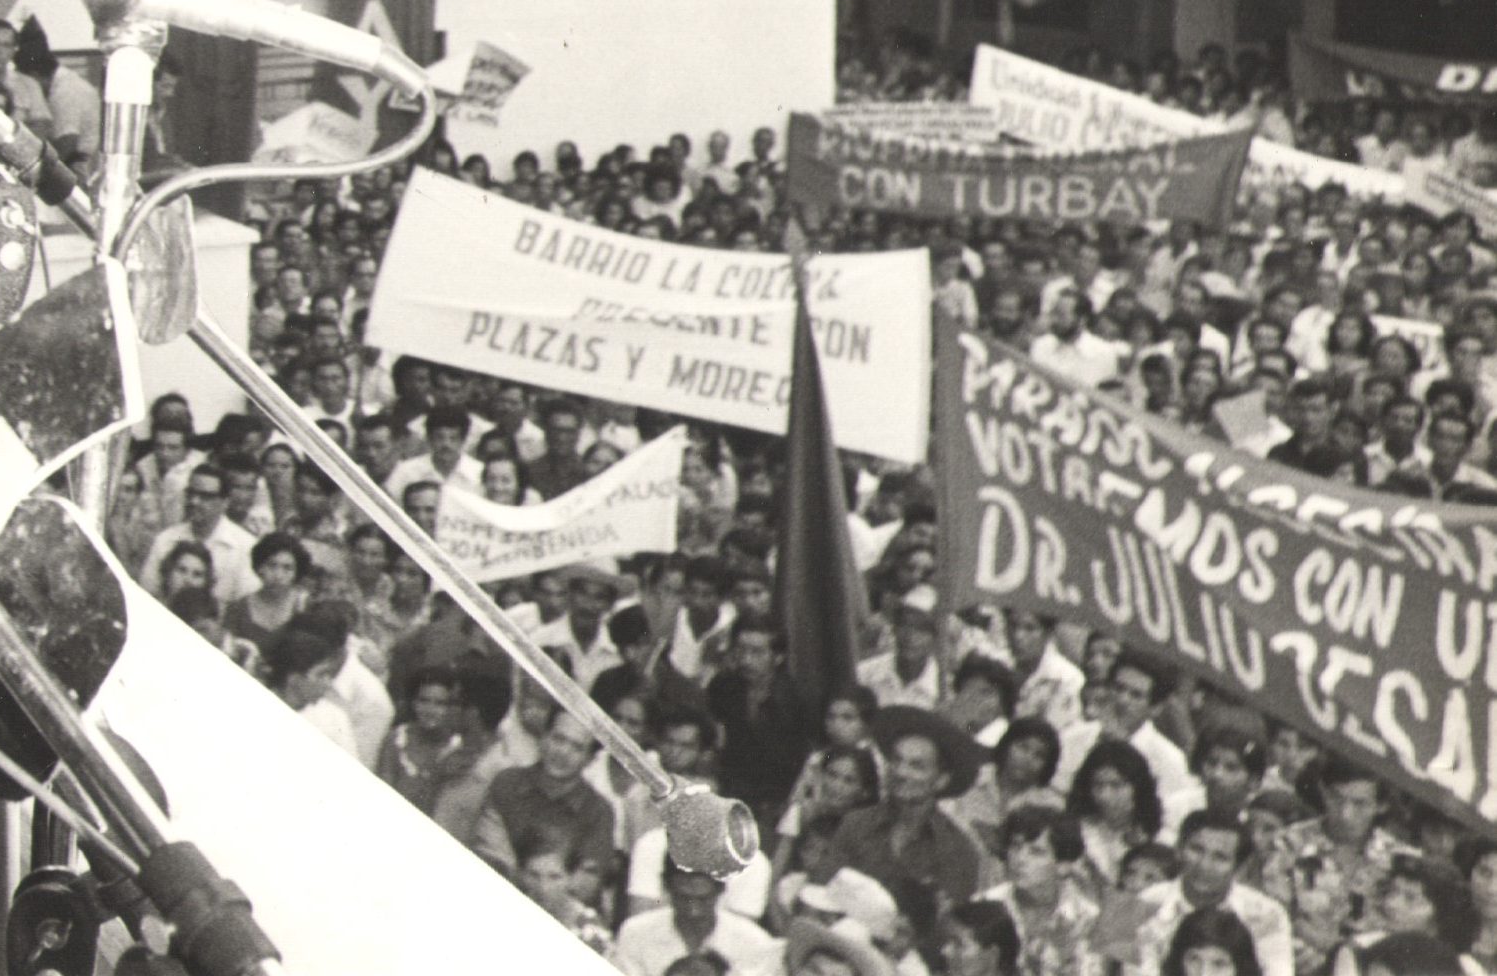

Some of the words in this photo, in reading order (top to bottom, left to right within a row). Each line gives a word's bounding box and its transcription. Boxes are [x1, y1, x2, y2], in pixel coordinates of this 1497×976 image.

[839, 165, 922, 210] CON
[951, 173, 1170, 220] TURBAY
[513, 219, 650, 285] BARRIO
[658, 256, 704, 294] LA
[463, 308, 607, 372] PLAZAS
[625, 343, 646, 380] Y
[976, 486, 1082, 606] DR.
[1294, 548, 1405, 647] CON
